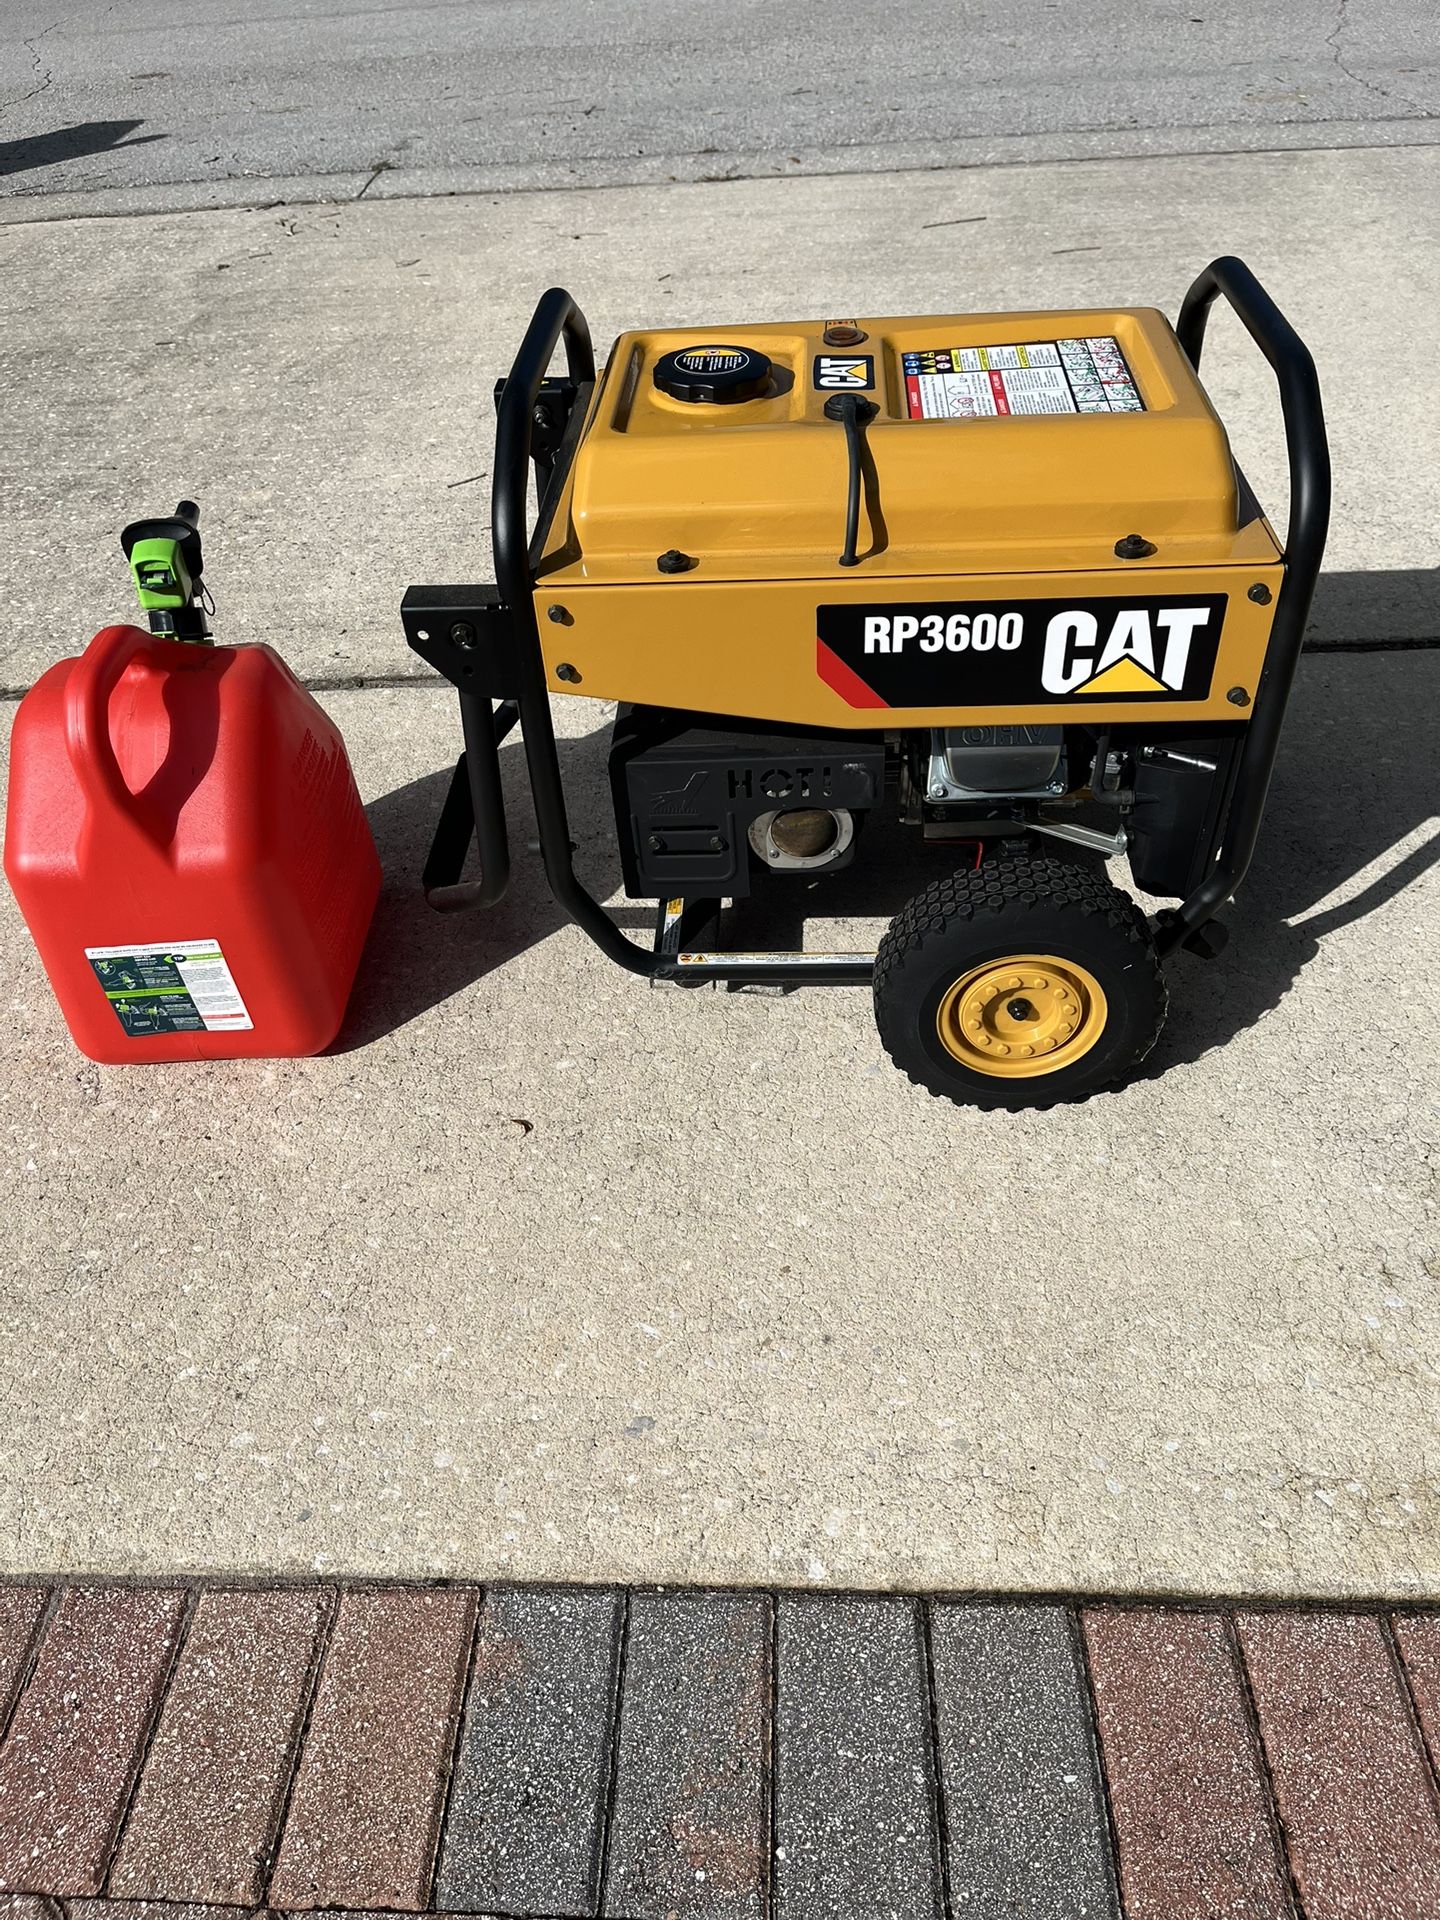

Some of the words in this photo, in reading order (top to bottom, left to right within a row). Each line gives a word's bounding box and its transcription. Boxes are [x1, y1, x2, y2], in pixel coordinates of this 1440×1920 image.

[819, 358, 867, 387] CAT
[864, 612, 1024, 654] RP3600
[1041, 607, 1211, 694] CAT
[962, 725, 1050, 745] OHV
[727, 767, 833, 798] HOT!
